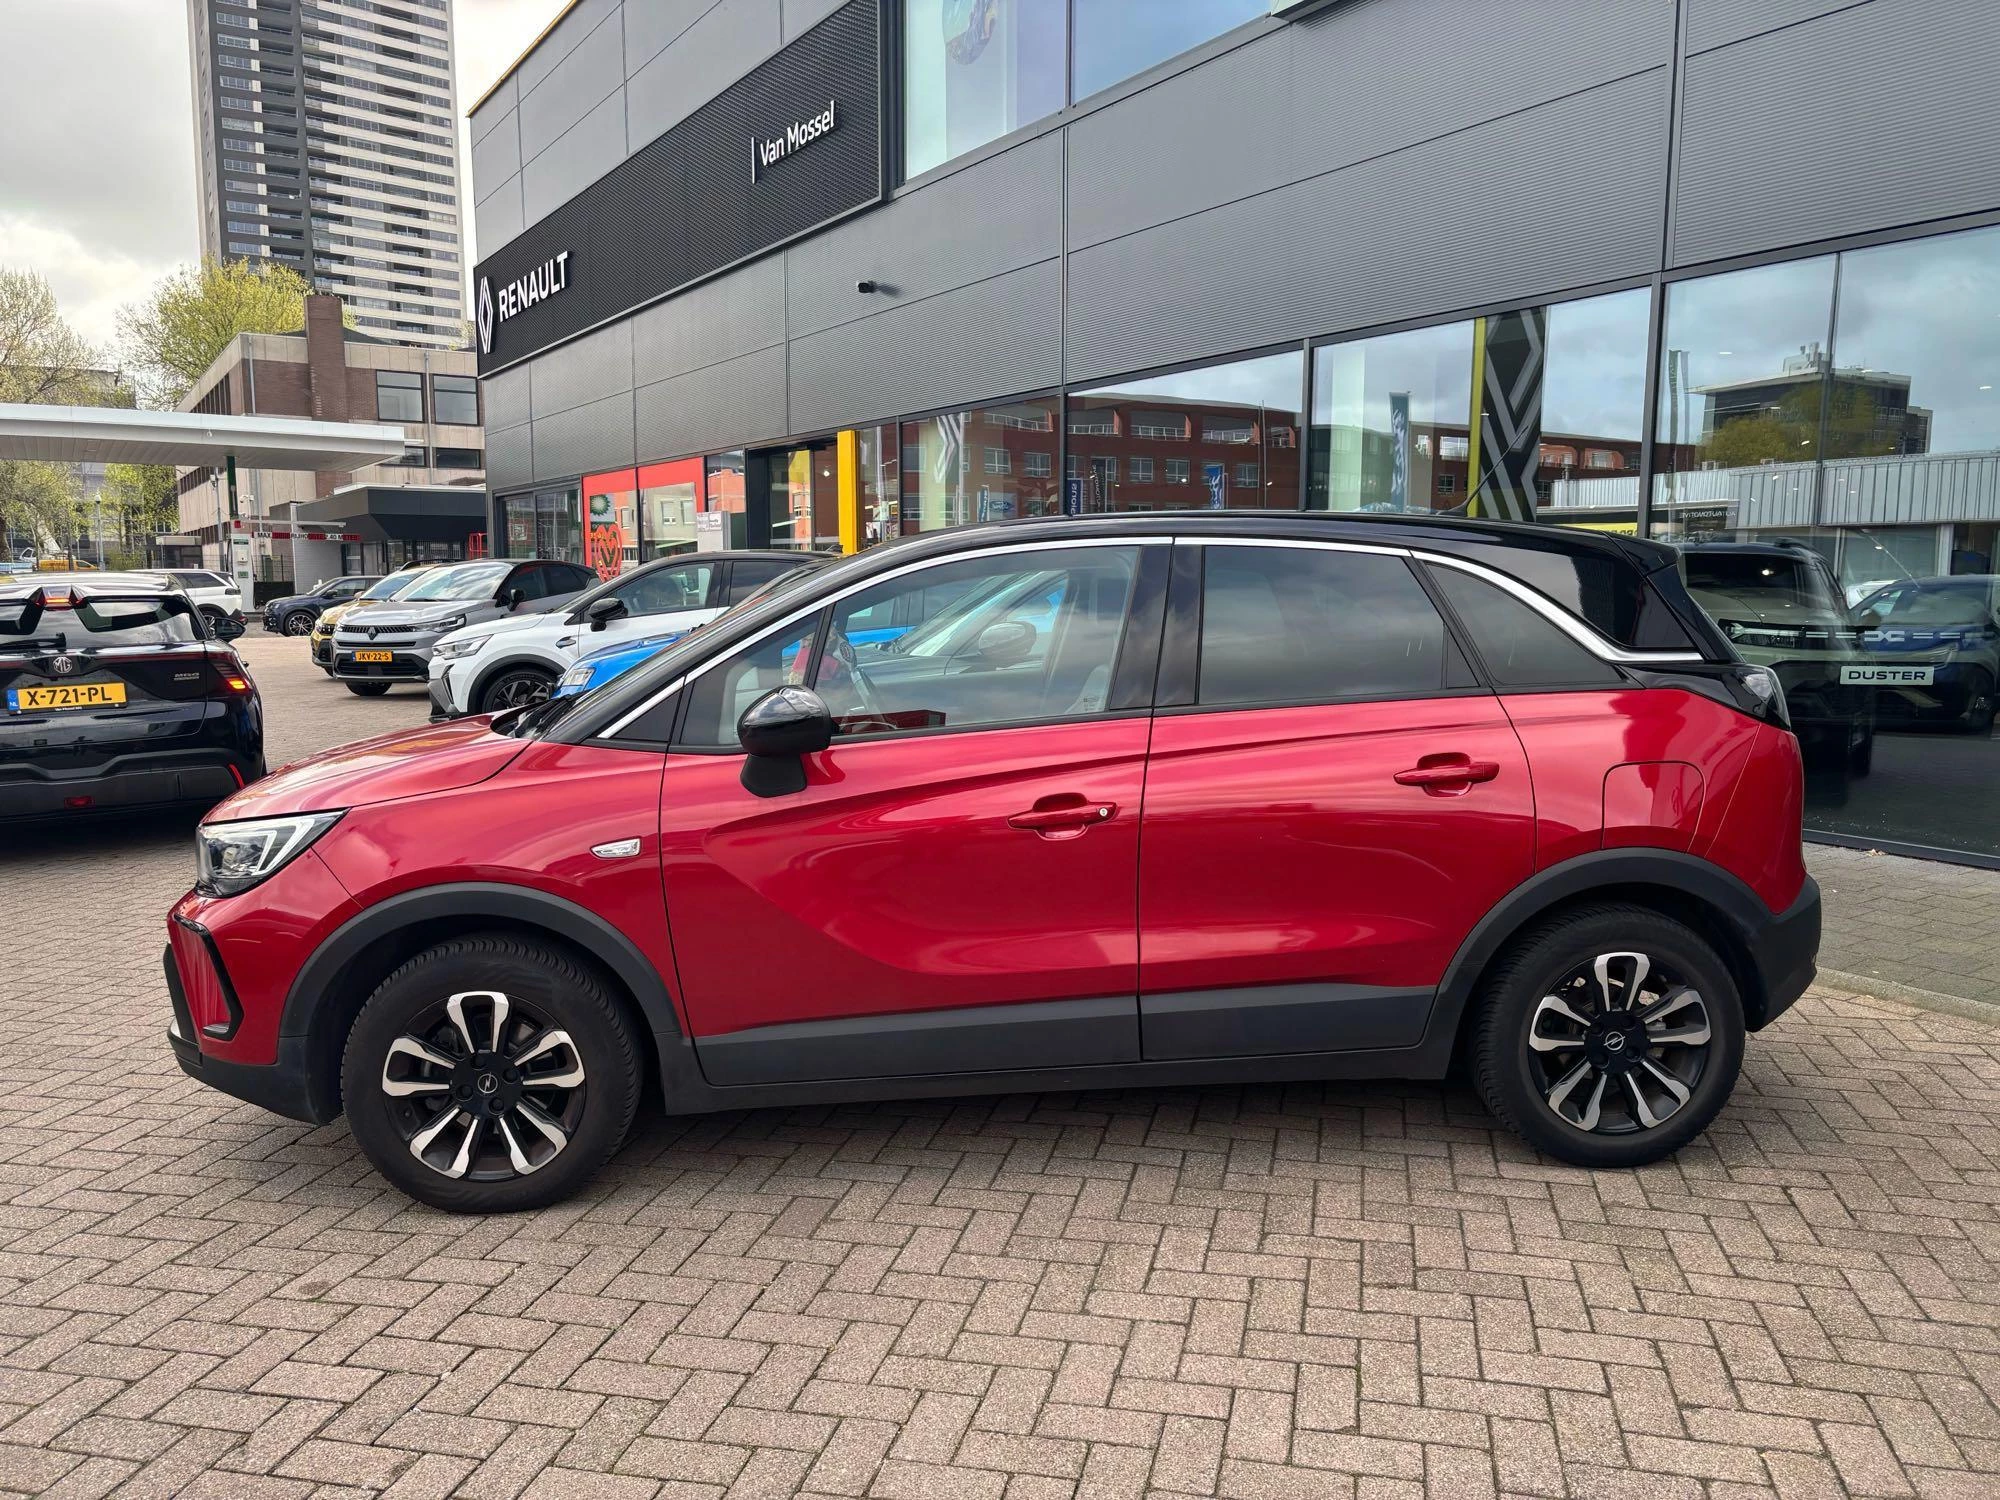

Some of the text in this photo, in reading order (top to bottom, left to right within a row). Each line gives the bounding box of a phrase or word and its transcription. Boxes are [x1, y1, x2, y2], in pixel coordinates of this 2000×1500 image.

[760, 100, 835, 167] Van Mossel
[499, 250, 568, 323] RENAULT
[53, 656, 73, 674] MG
[358, 652, 390, 661] JKV-22-S
[1848, 670, 1927, 681] DUSTER
[26, 686, 113, 706] X-721-PL
